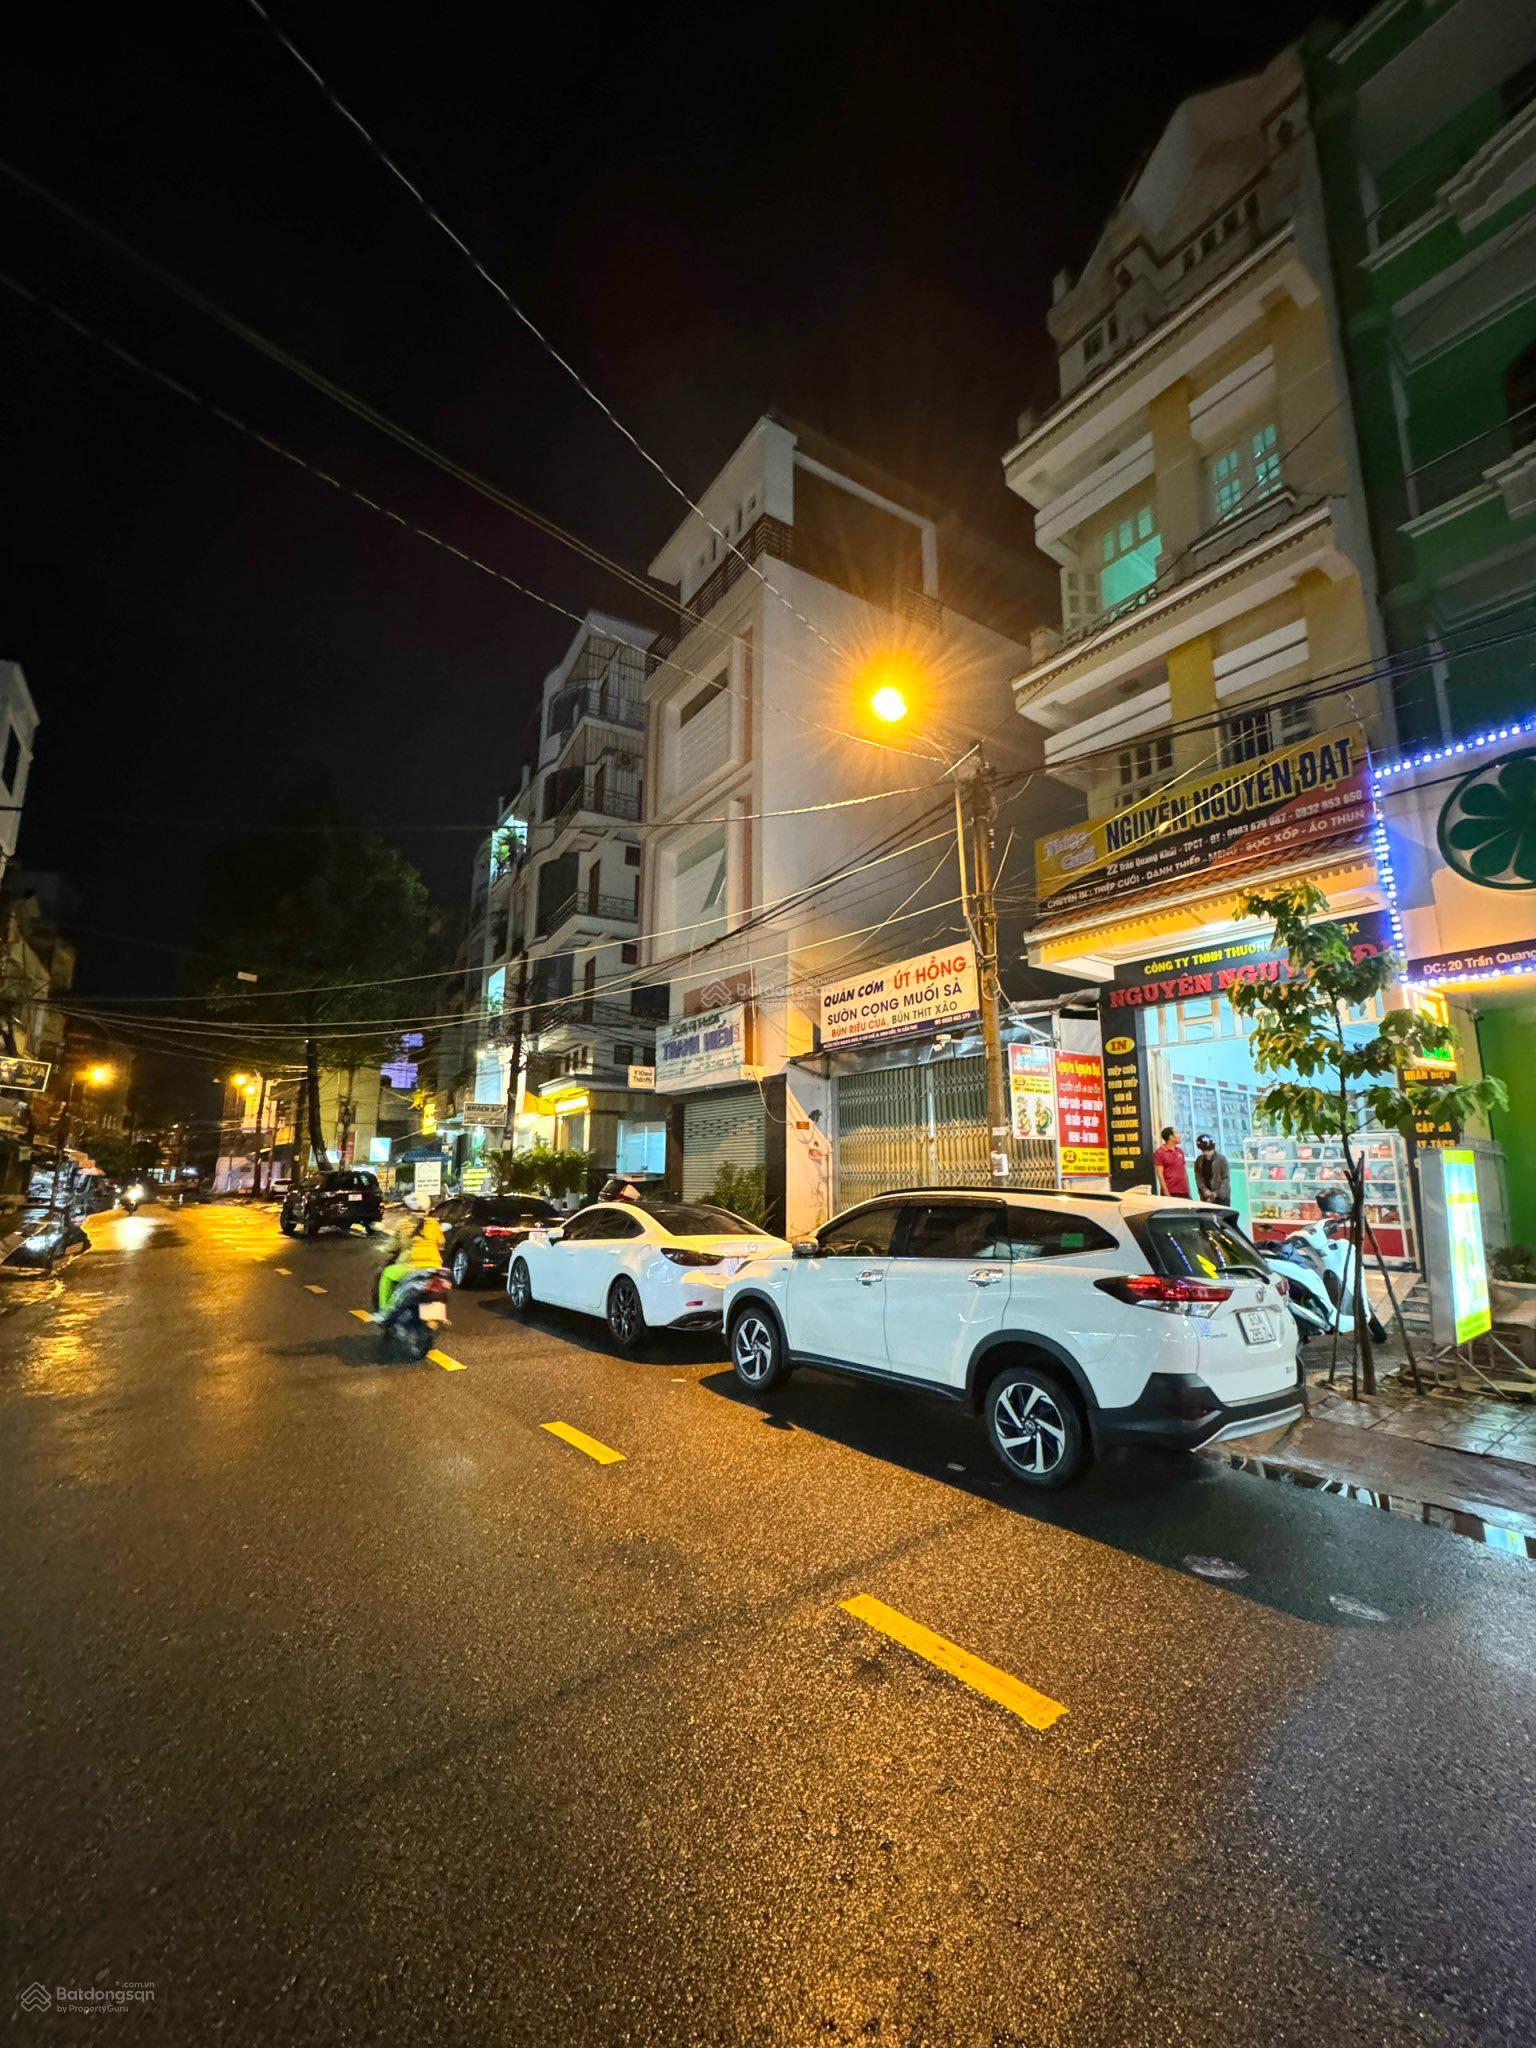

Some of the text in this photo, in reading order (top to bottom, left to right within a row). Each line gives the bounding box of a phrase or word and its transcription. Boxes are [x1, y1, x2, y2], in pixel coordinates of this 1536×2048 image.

[1106, 737, 1351, 853] NGUYÊN NGUYÊN ĐẠT
[1107, 865, 1118, 876] 22
[1183, 838, 1203, 852] TPCT
[1146, 864, 1173, 880] DANH
[1330, 808, 1365, 826] THUN
[1144, 961, 1173, 975] CÔNG
[1175, 956, 1189, 969] TY
[1192, 949, 1223, 965] TNHH
[1448, 960, 1463, 972] 20
[824, 956, 967, 1007] QUÁN CƠM ÚT HỒNG
[861, 997, 899, 1017] CỌNG
[903, 982, 939, 1007] MUỐI
[944, 976, 963, 997] SẢ
[1110, 972, 1213, 1008] NGUYÊN
[891, 1010, 910, 1025] BÚN
[1110, 1040, 1127, 1051] IN
[22, 1064, 45, 1077] SPA
